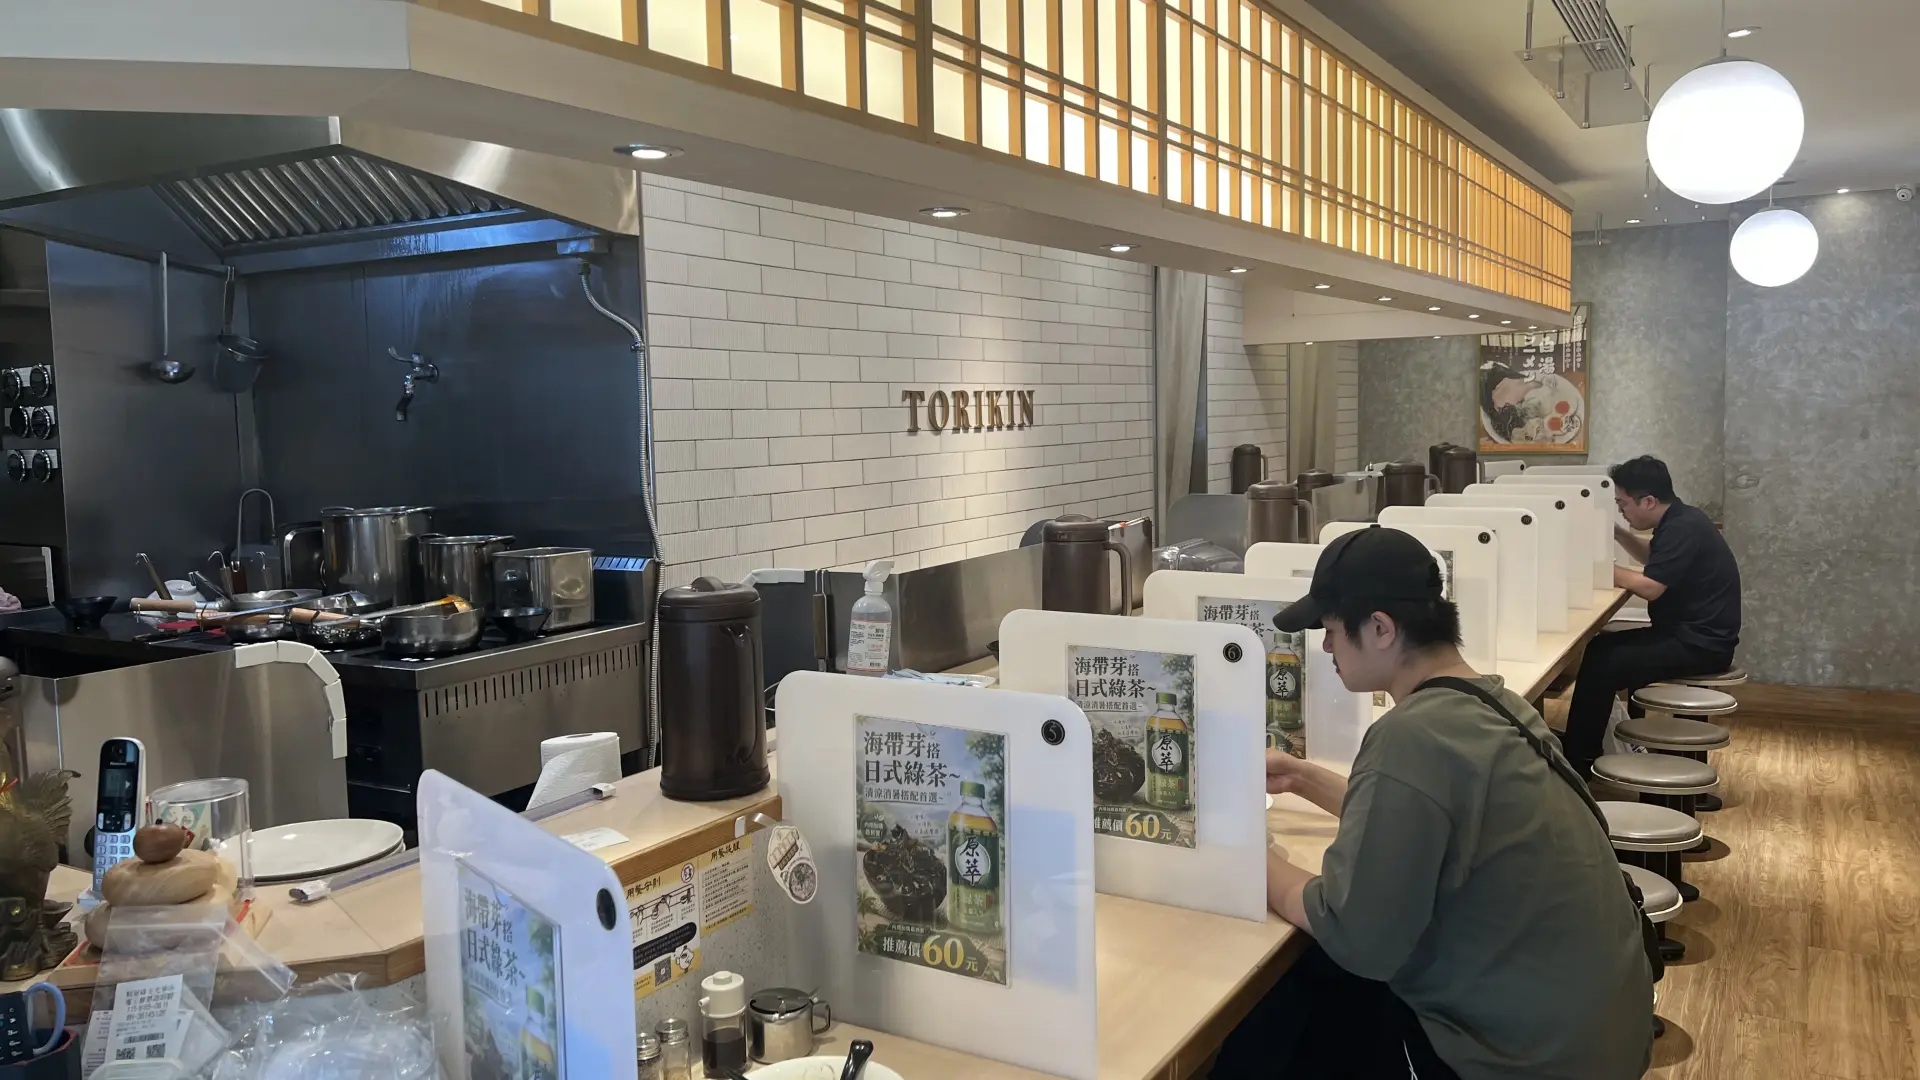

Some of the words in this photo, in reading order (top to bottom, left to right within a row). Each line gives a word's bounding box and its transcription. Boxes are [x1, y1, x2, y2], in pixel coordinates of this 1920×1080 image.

[902, 390, 1035, 432] TORIKIN
[1204, 605, 1260, 621] 海帶芽搭
[1075, 656, 1140, 677] 海帶芽搭
[1076, 679, 1157, 699] 日式綠茶~
[1272, 667, 1289, 698] 原萃
[863, 730, 941, 759] 海帶芽搭
[1156, 735, 1175, 773] 原萃
[865, 759, 961, 788] 日式綠茶~
[960, 835, 982, 887] 原萃
